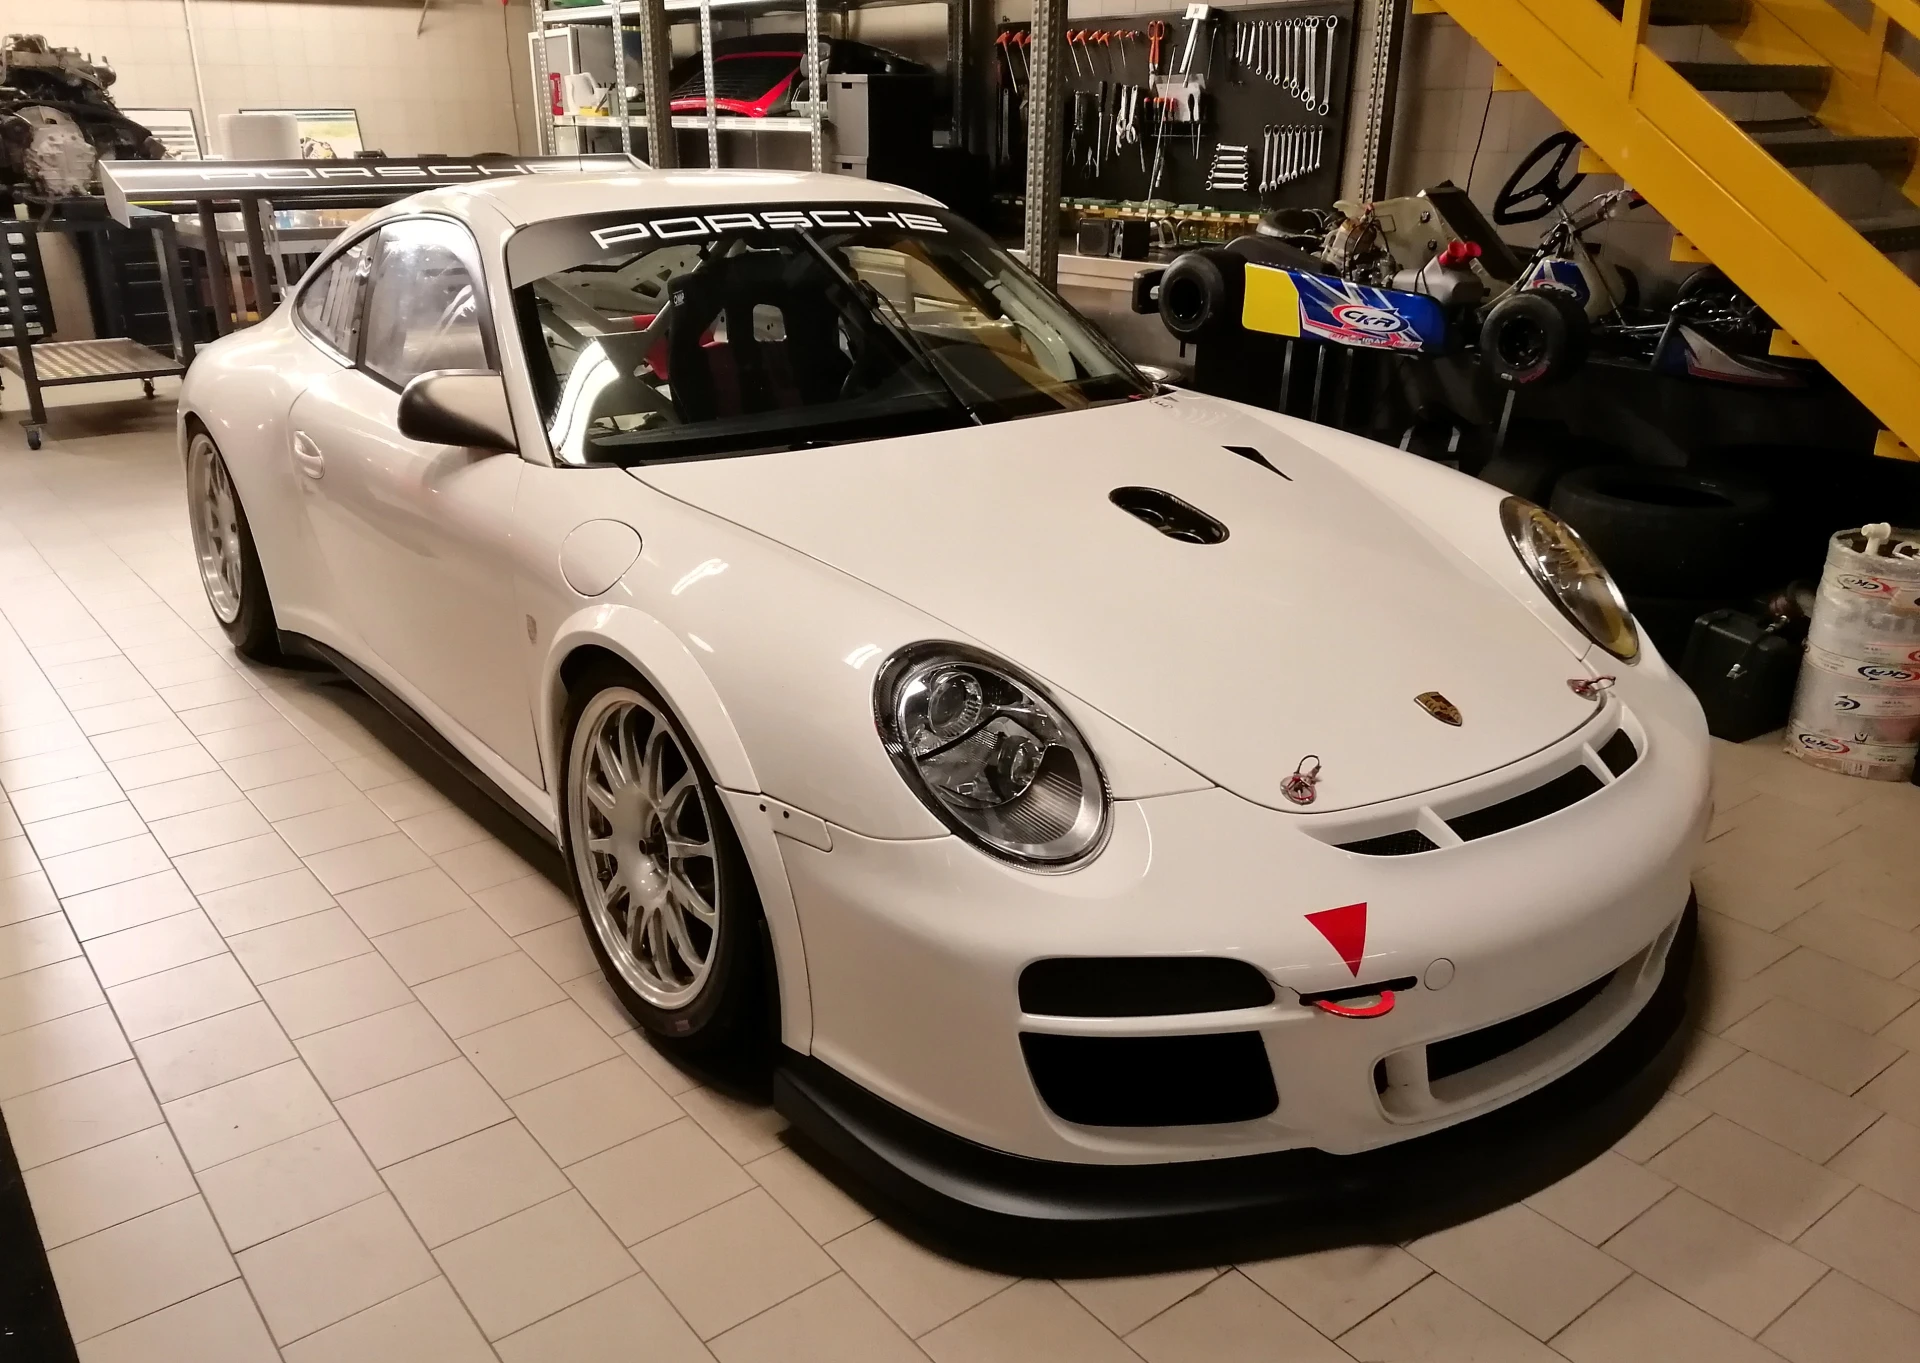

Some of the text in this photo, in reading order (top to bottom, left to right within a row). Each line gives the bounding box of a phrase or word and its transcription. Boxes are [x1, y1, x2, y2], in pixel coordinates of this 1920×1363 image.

[589, 211, 949, 249] PORSCHE
[1343, 310, 1396, 328] CKR
[1867, 668, 1911, 680] CKR
